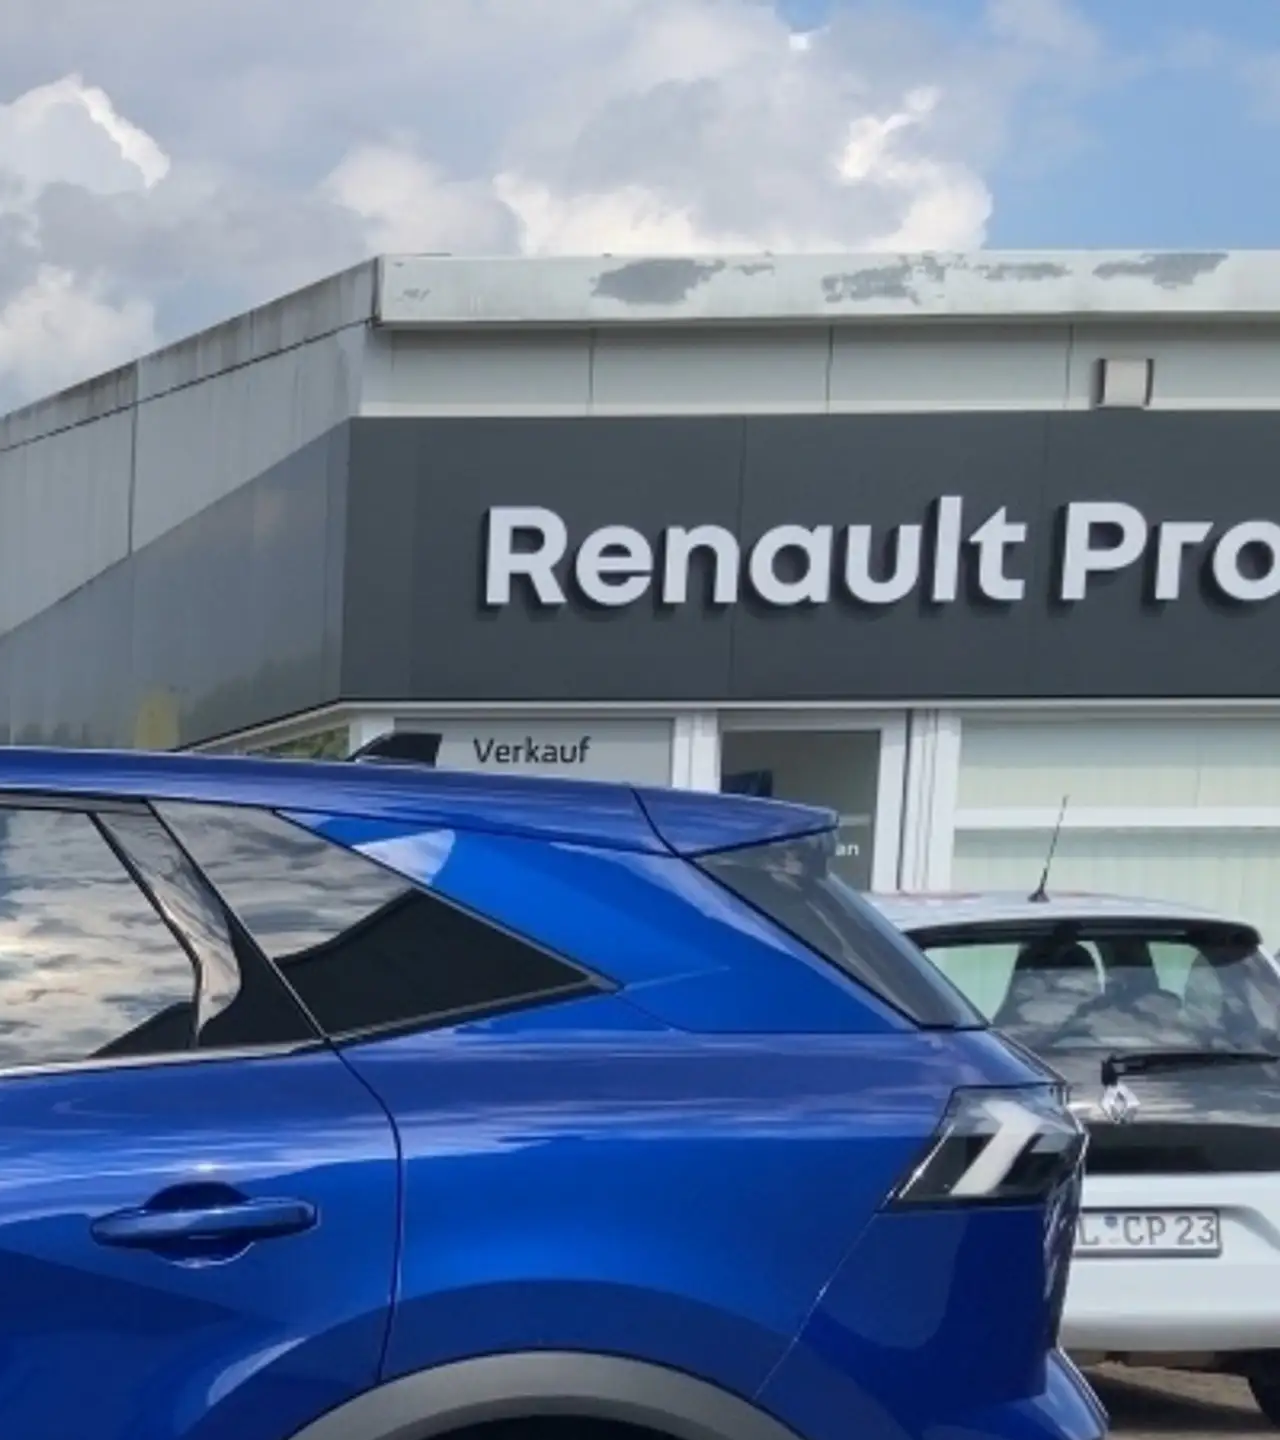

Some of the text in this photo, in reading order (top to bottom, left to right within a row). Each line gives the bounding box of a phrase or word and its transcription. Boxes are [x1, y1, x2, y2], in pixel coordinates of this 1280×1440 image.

[484, 496, 1280, 605] Renault Pro
[473, 736, 591, 763] Verkauf
[1123, 1215, 1166, 1246] CP
[1174, 1215, 1215, 1245] 23
